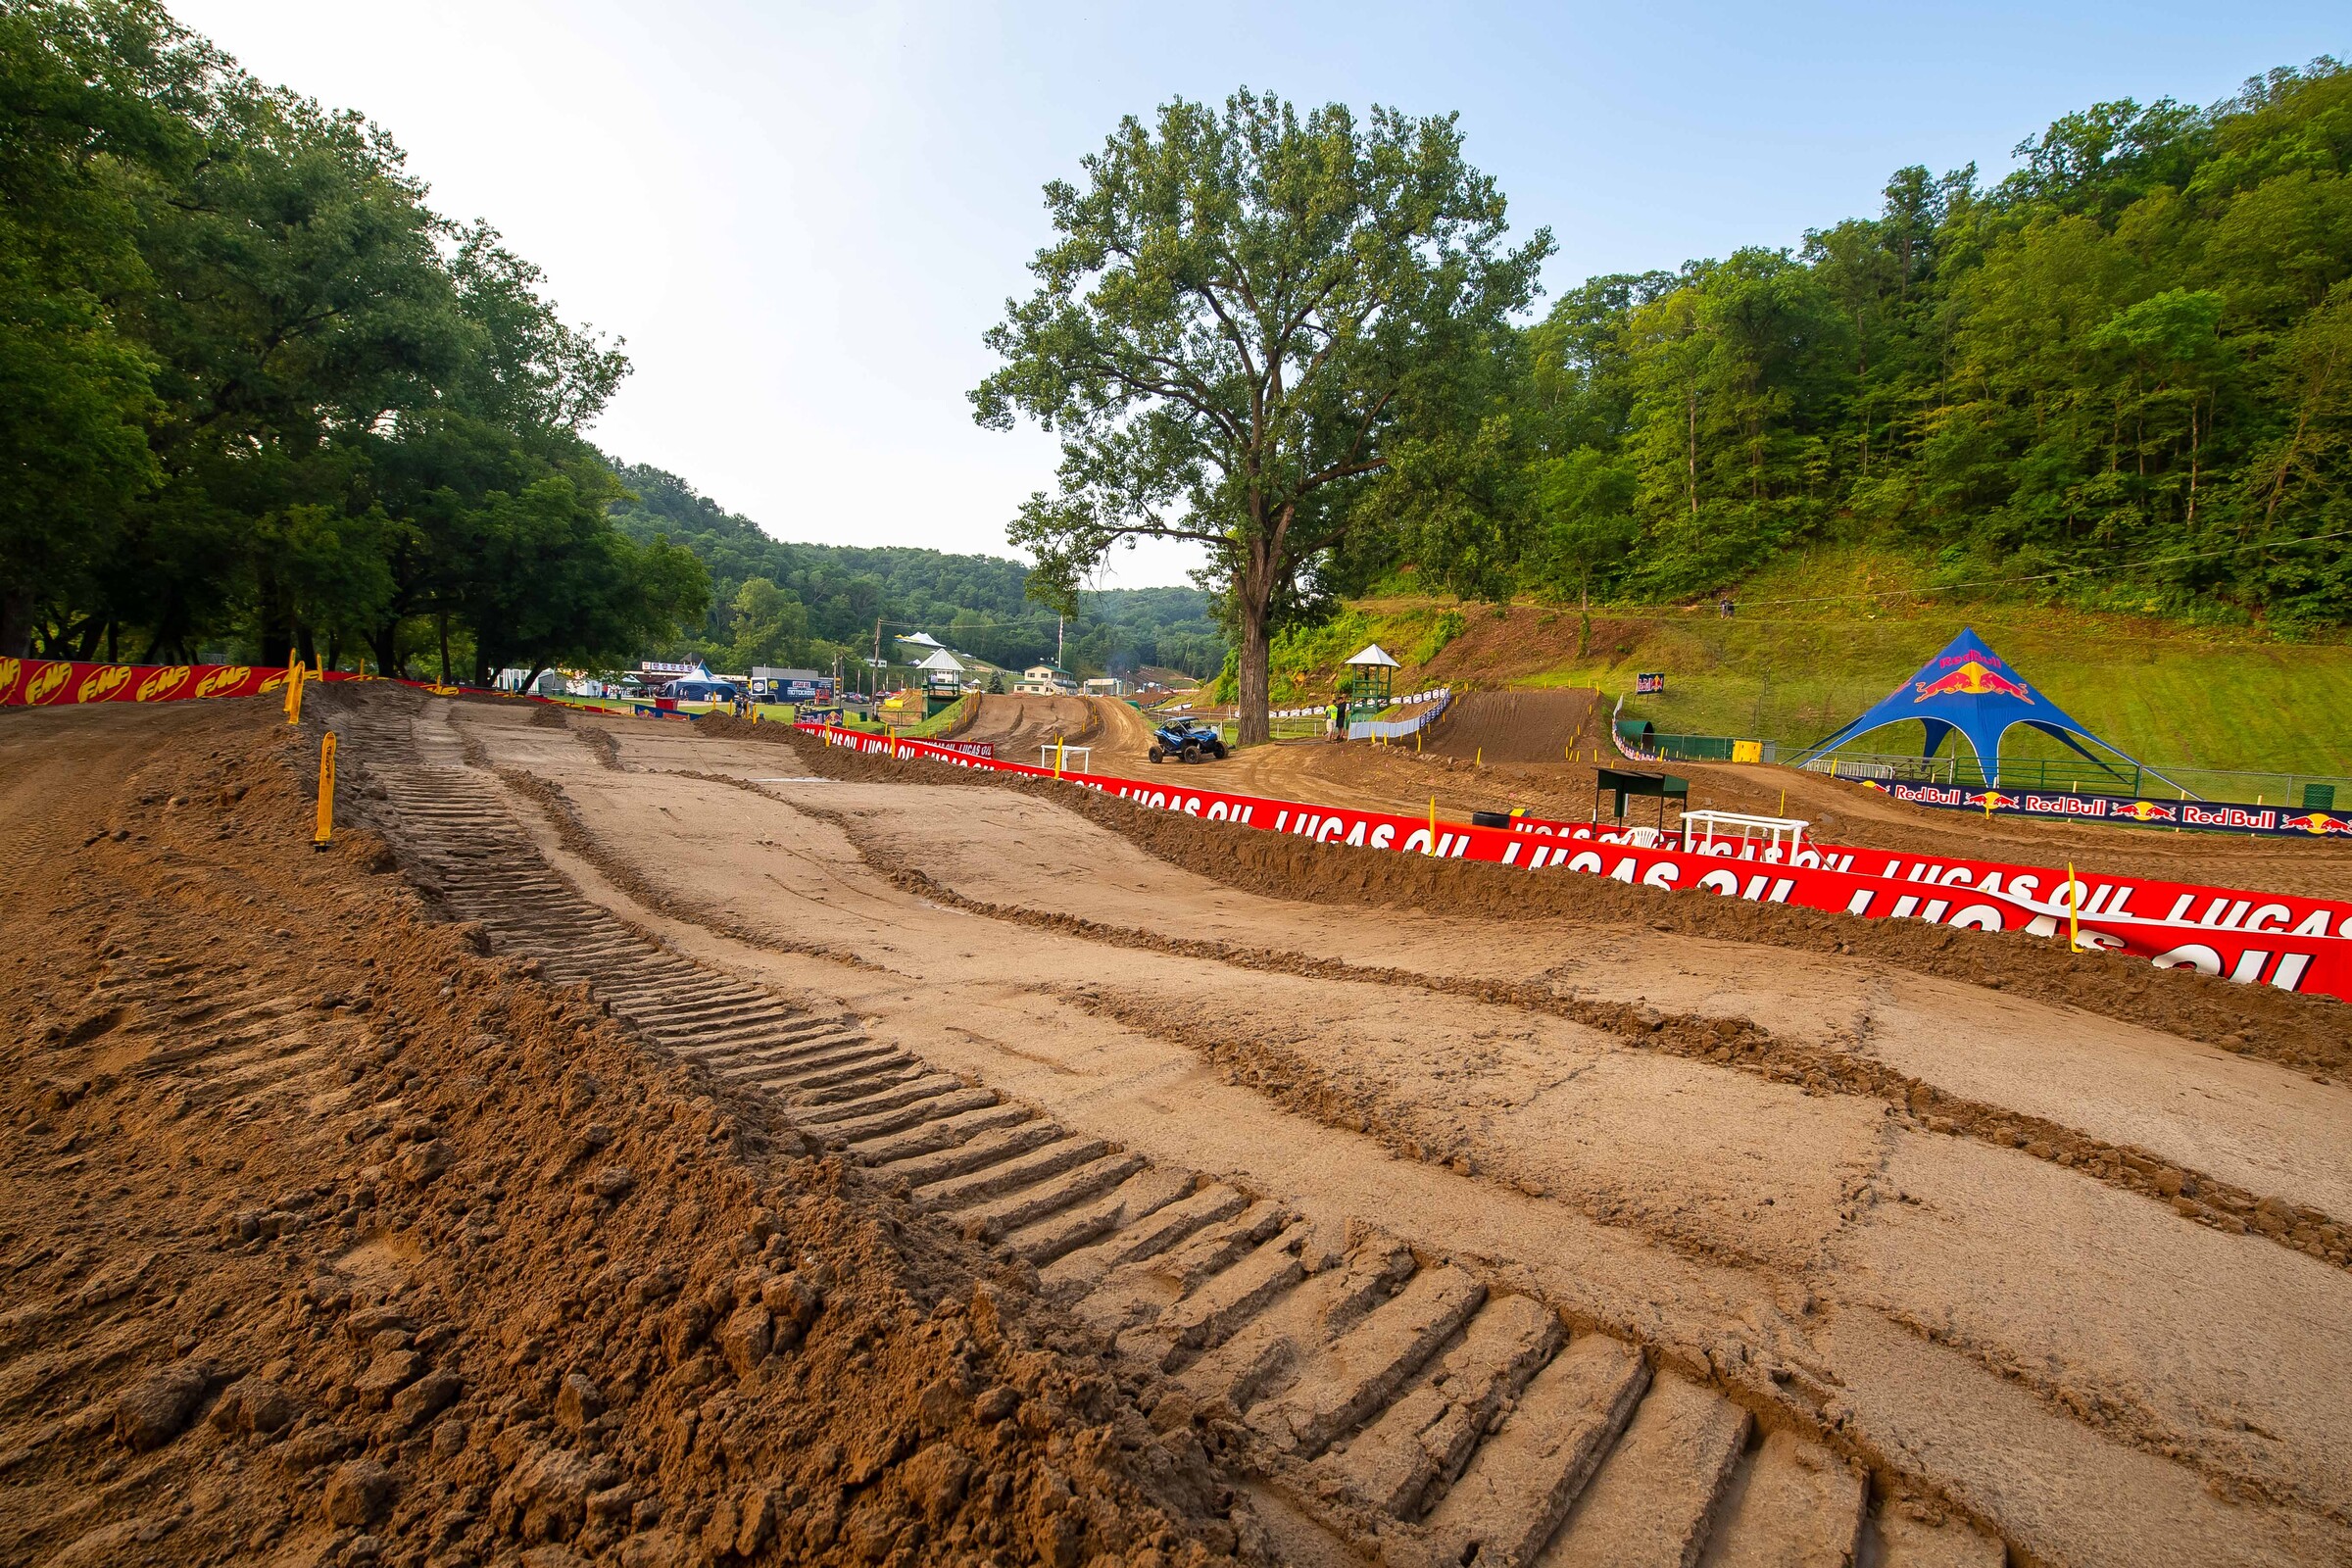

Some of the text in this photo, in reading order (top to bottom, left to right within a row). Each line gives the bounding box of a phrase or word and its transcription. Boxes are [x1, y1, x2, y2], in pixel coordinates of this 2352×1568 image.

[26, 662, 71, 705] FMF
[78, 666, 129, 703] FMF
[137, 665, 189, 702] FMF
[197, 666, 250, 698] FMF
[2049, 880, 2133, 917] OIL
